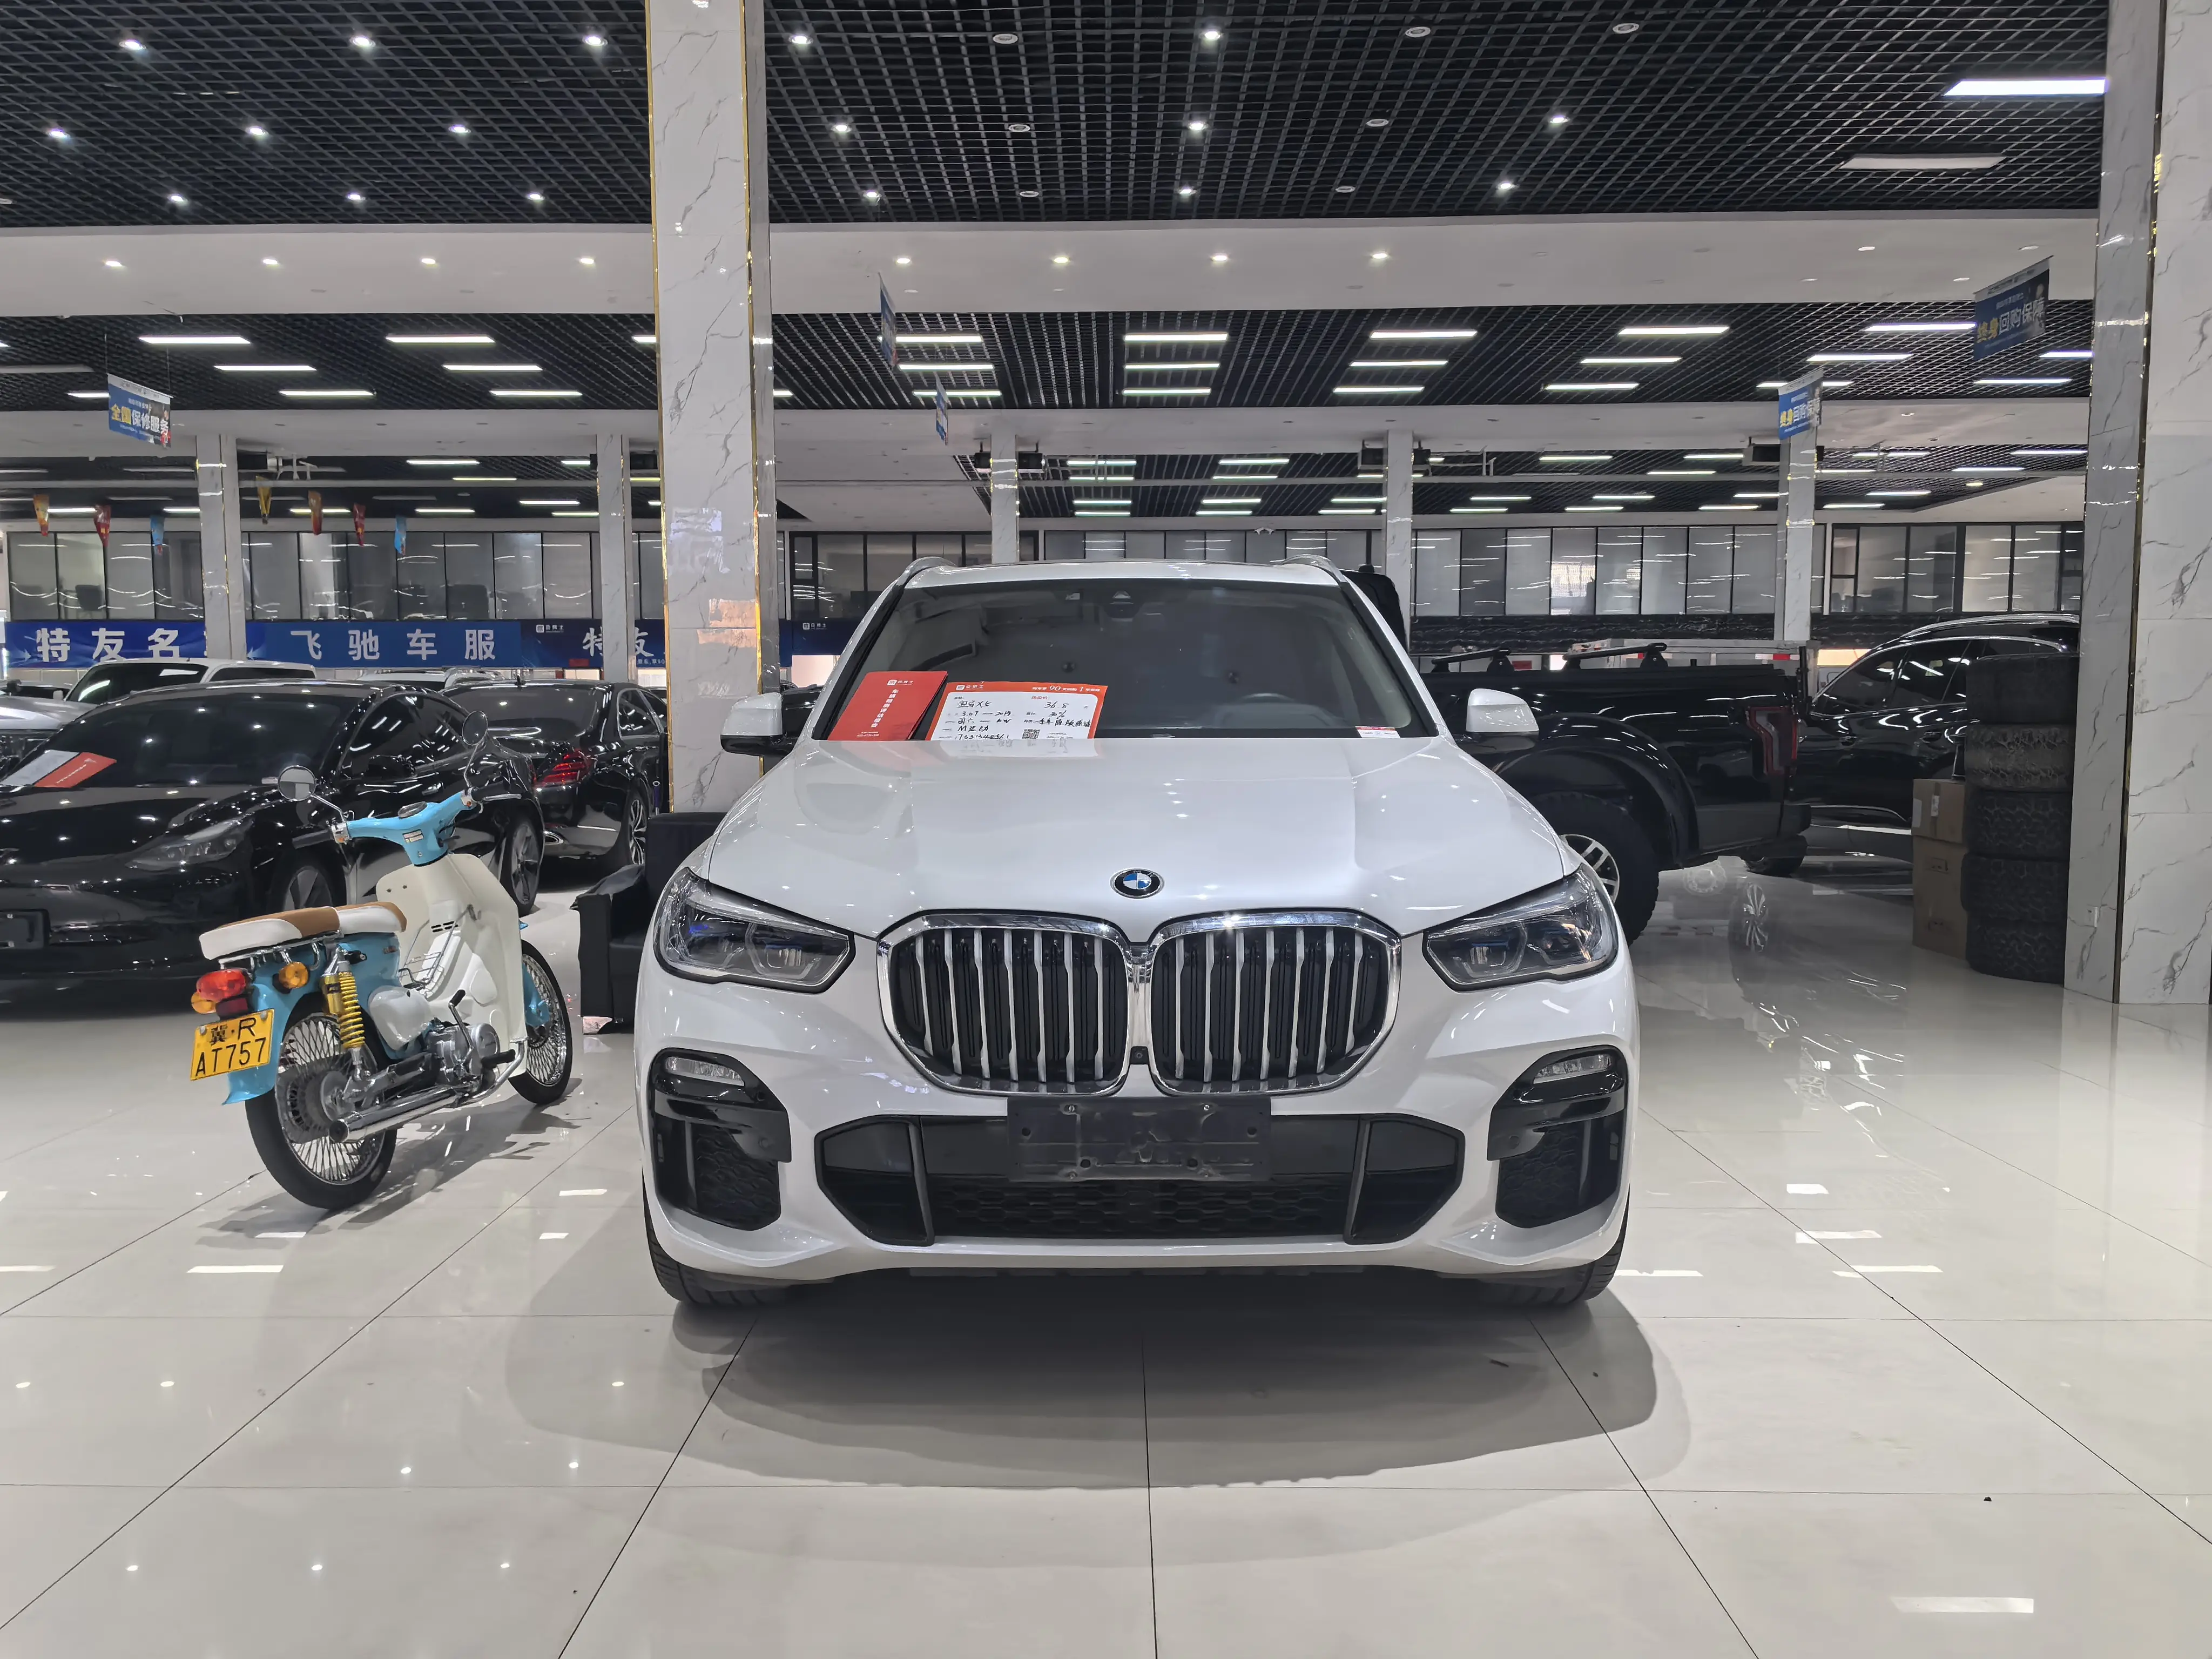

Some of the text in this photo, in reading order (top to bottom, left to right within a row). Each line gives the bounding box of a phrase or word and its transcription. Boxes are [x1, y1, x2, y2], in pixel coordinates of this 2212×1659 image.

[291, 629, 496, 660] 飞驰车服
[195, 1036, 266, 1076] AT757
